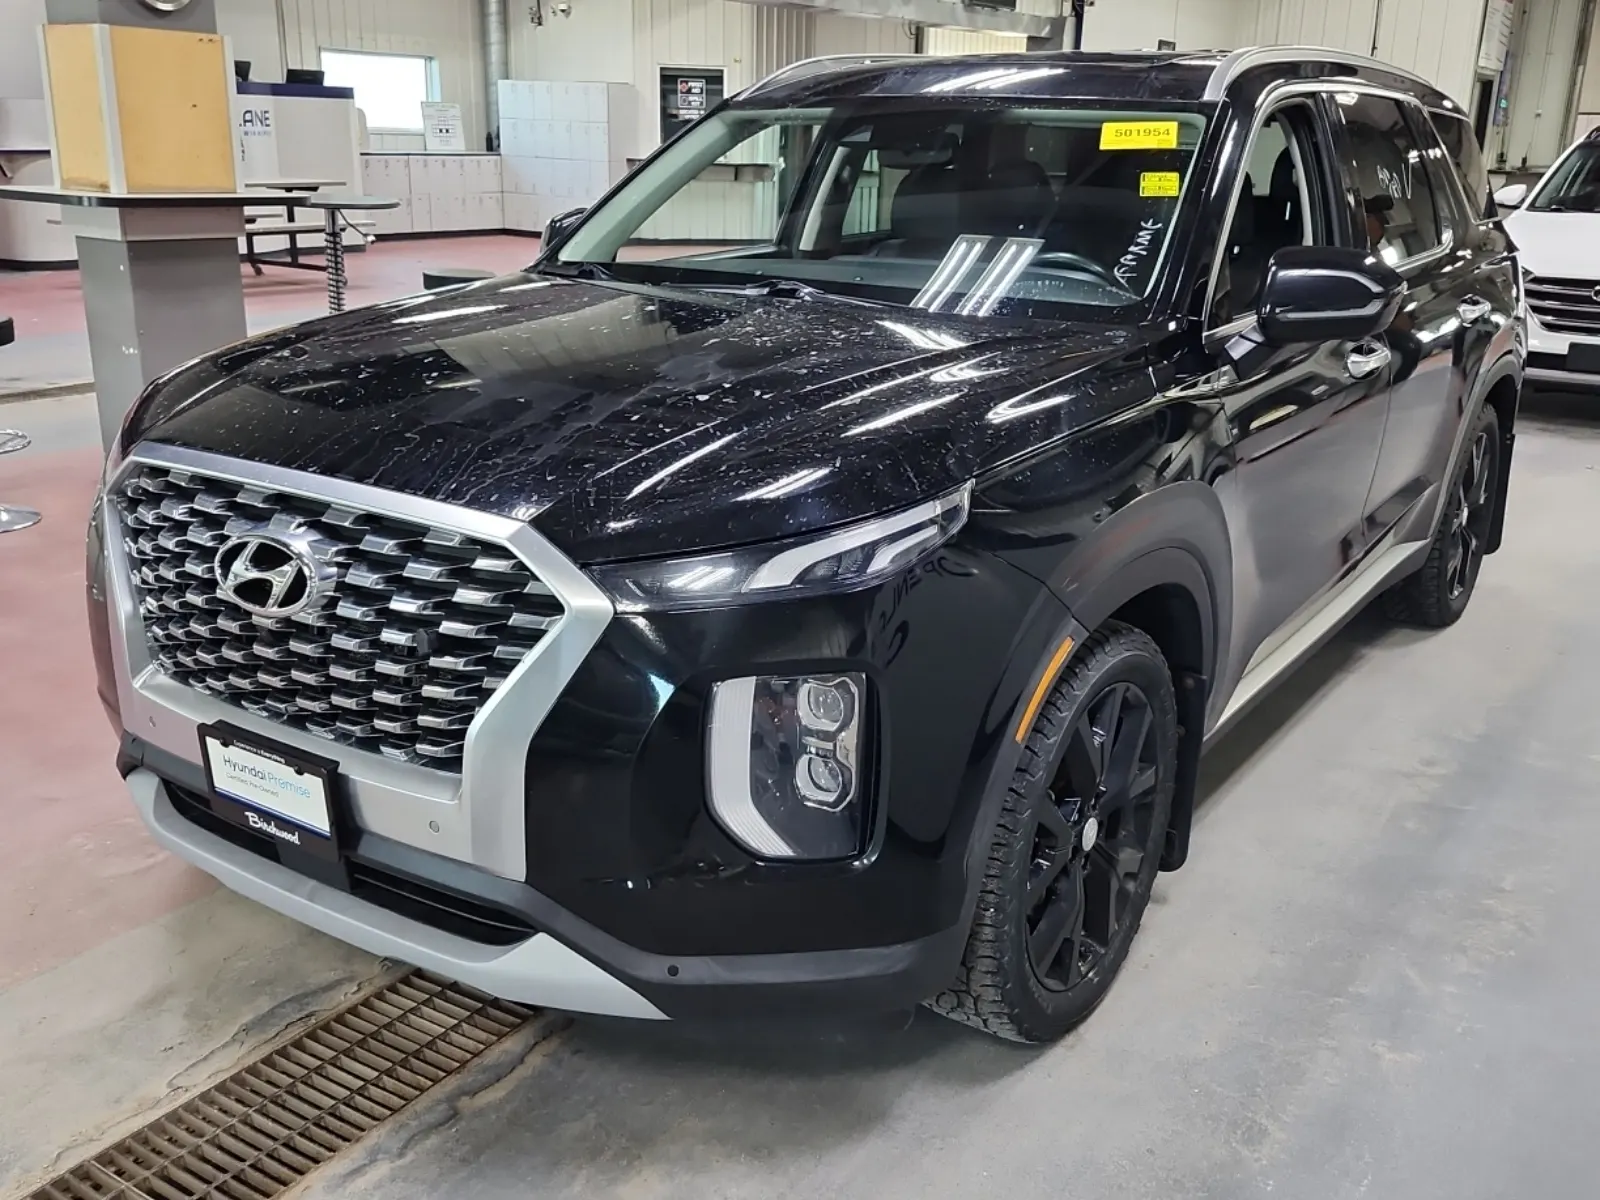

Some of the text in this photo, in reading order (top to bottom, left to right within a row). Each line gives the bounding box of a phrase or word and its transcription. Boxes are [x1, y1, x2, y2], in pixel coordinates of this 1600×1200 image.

[239, 109, 271, 127] ANE
[1114, 127, 1171, 138] 501954
[222, 754, 267, 781] Hyundai
